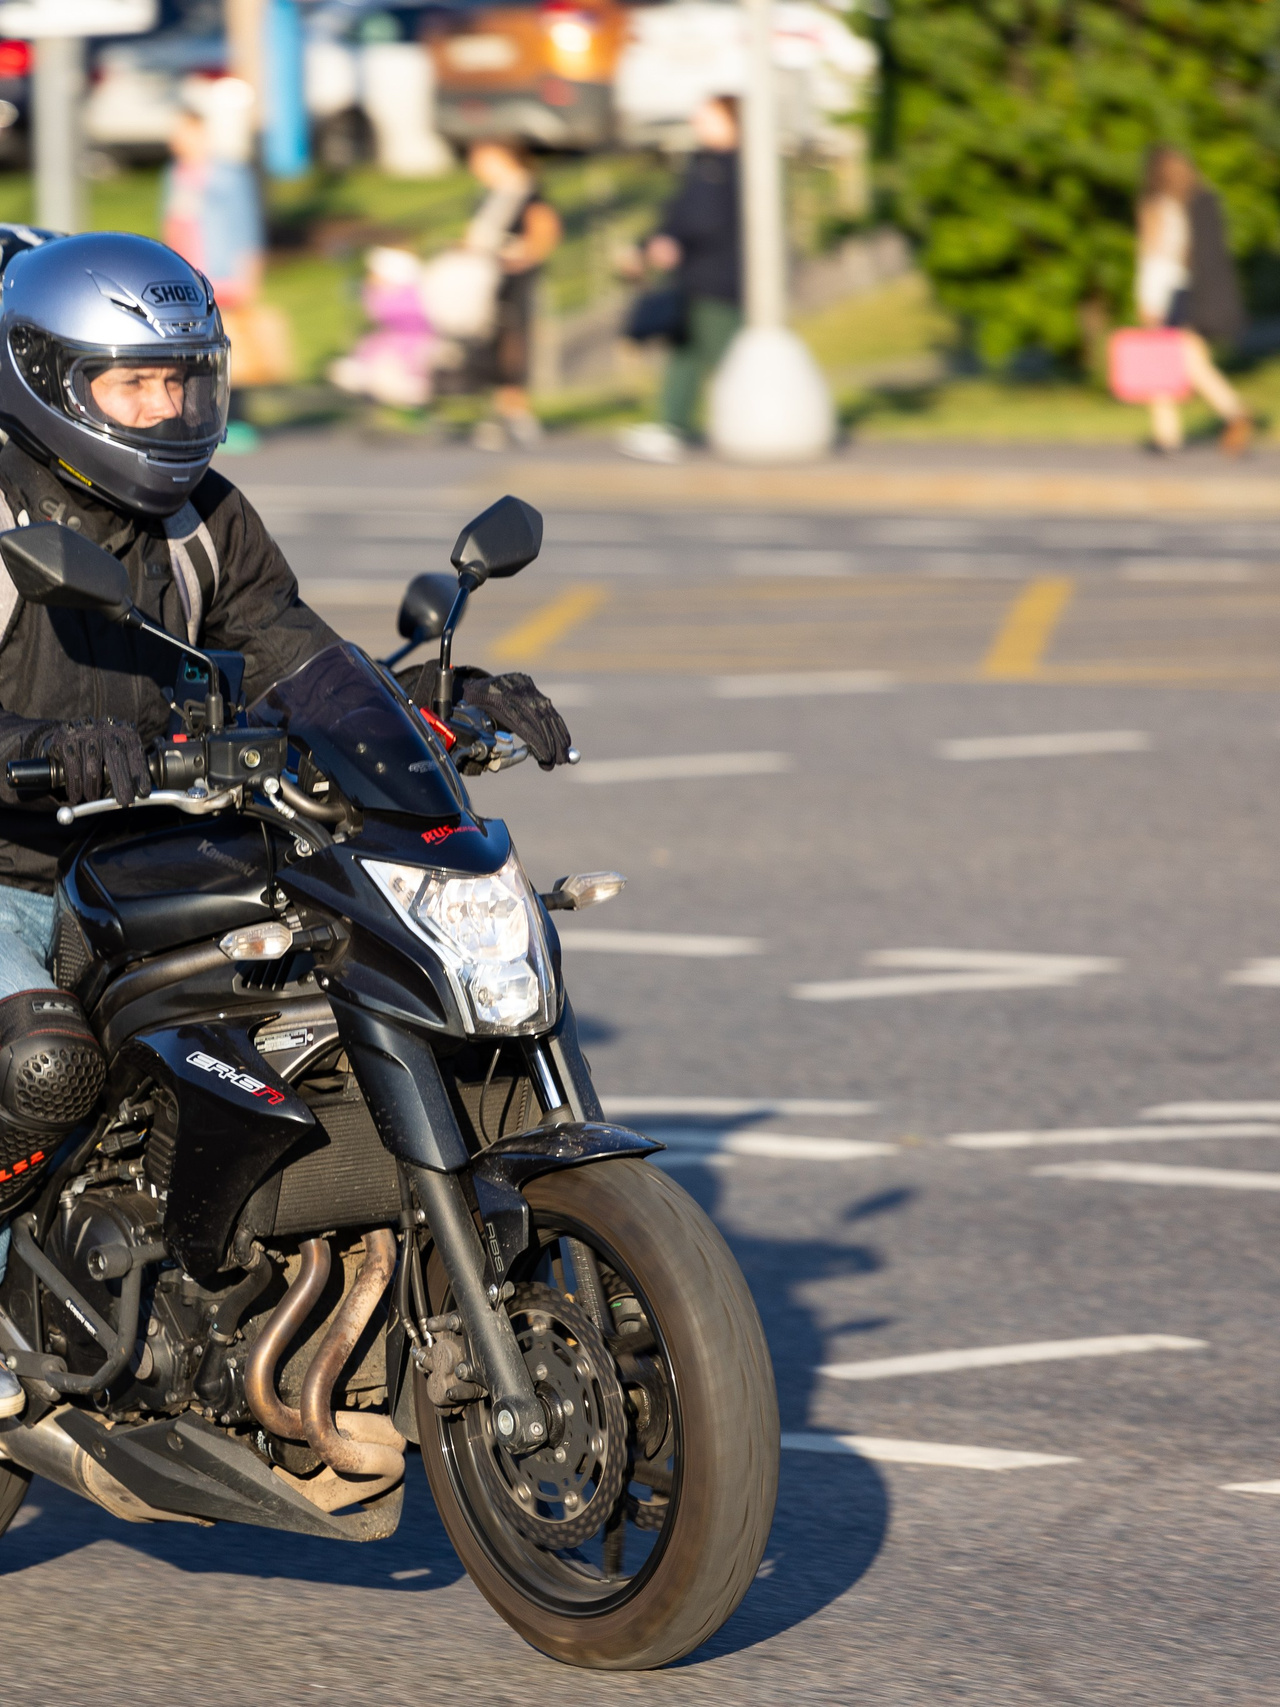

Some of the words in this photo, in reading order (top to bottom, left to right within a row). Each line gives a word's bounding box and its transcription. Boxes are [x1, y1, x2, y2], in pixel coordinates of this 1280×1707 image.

[149, 285, 199, 304] SHOEI
[421, 824, 454, 845] RUS
[197, 838, 261, 878] Kawasaki
[485, 1222, 505, 1273] ABS
